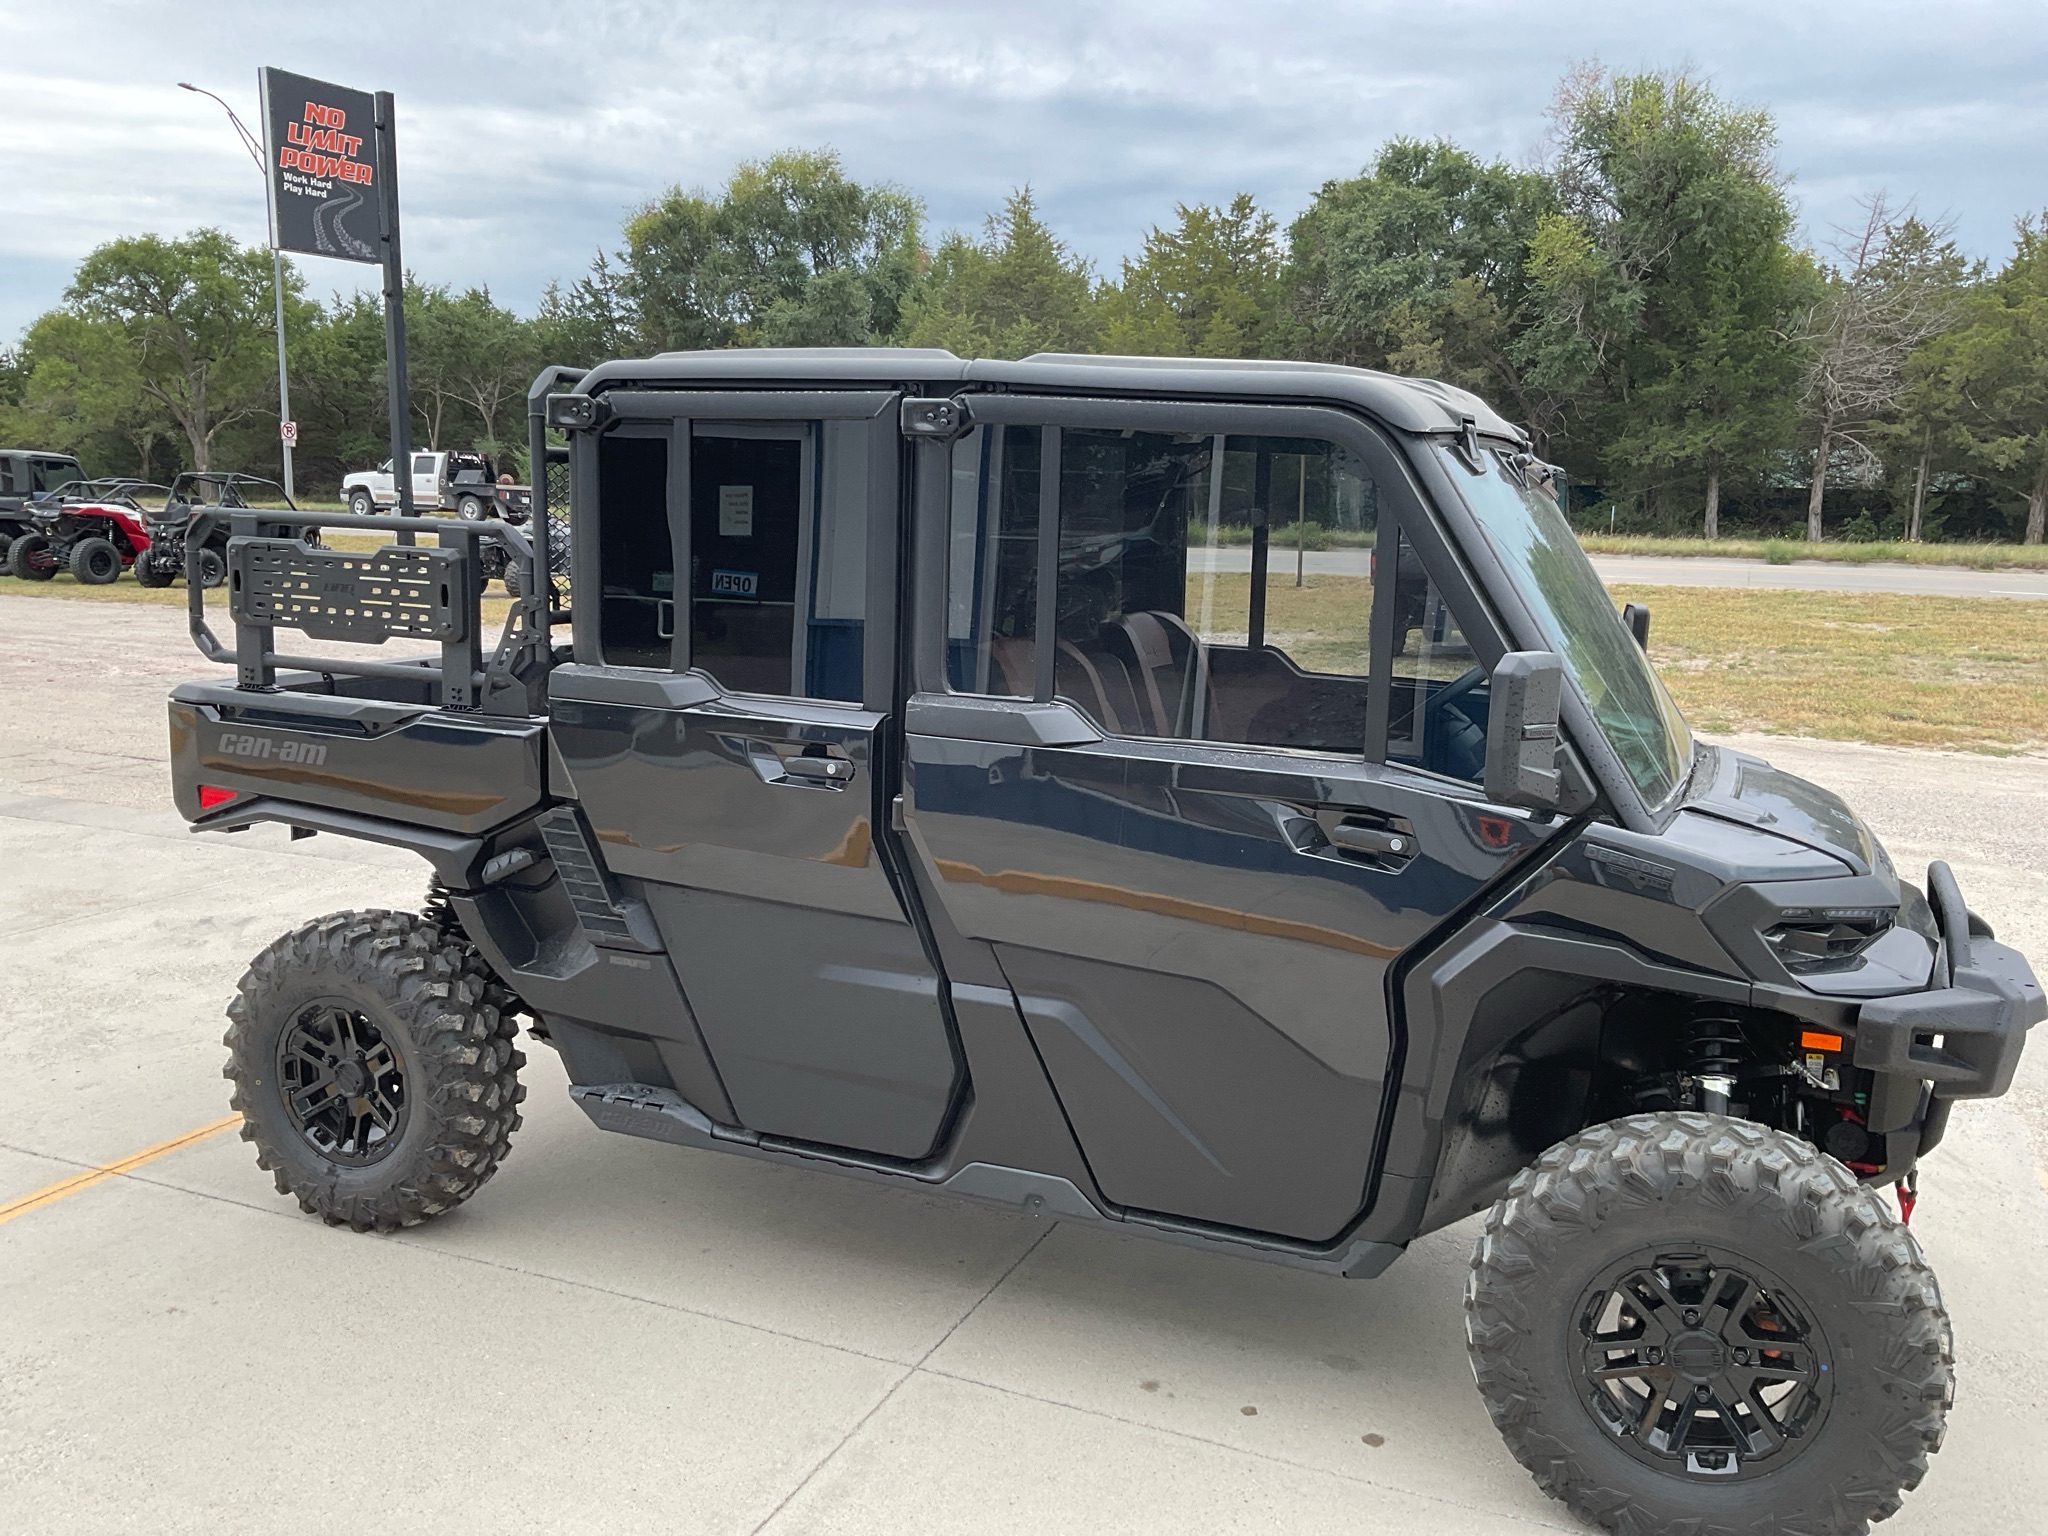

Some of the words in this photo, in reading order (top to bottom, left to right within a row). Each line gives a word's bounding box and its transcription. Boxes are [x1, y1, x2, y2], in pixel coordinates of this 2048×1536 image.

[304, 101, 346, 130] NO
[287, 122, 362, 156] LIMIT
[283, 171, 308, 185] Work
[310, 177, 332, 189] Hard
[283, 182, 303, 196] Play
[305, 186, 327, 198] Hard
[218, 732, 327, 766] can-am
[1585, 847, 1675, 878] DEFENDER
